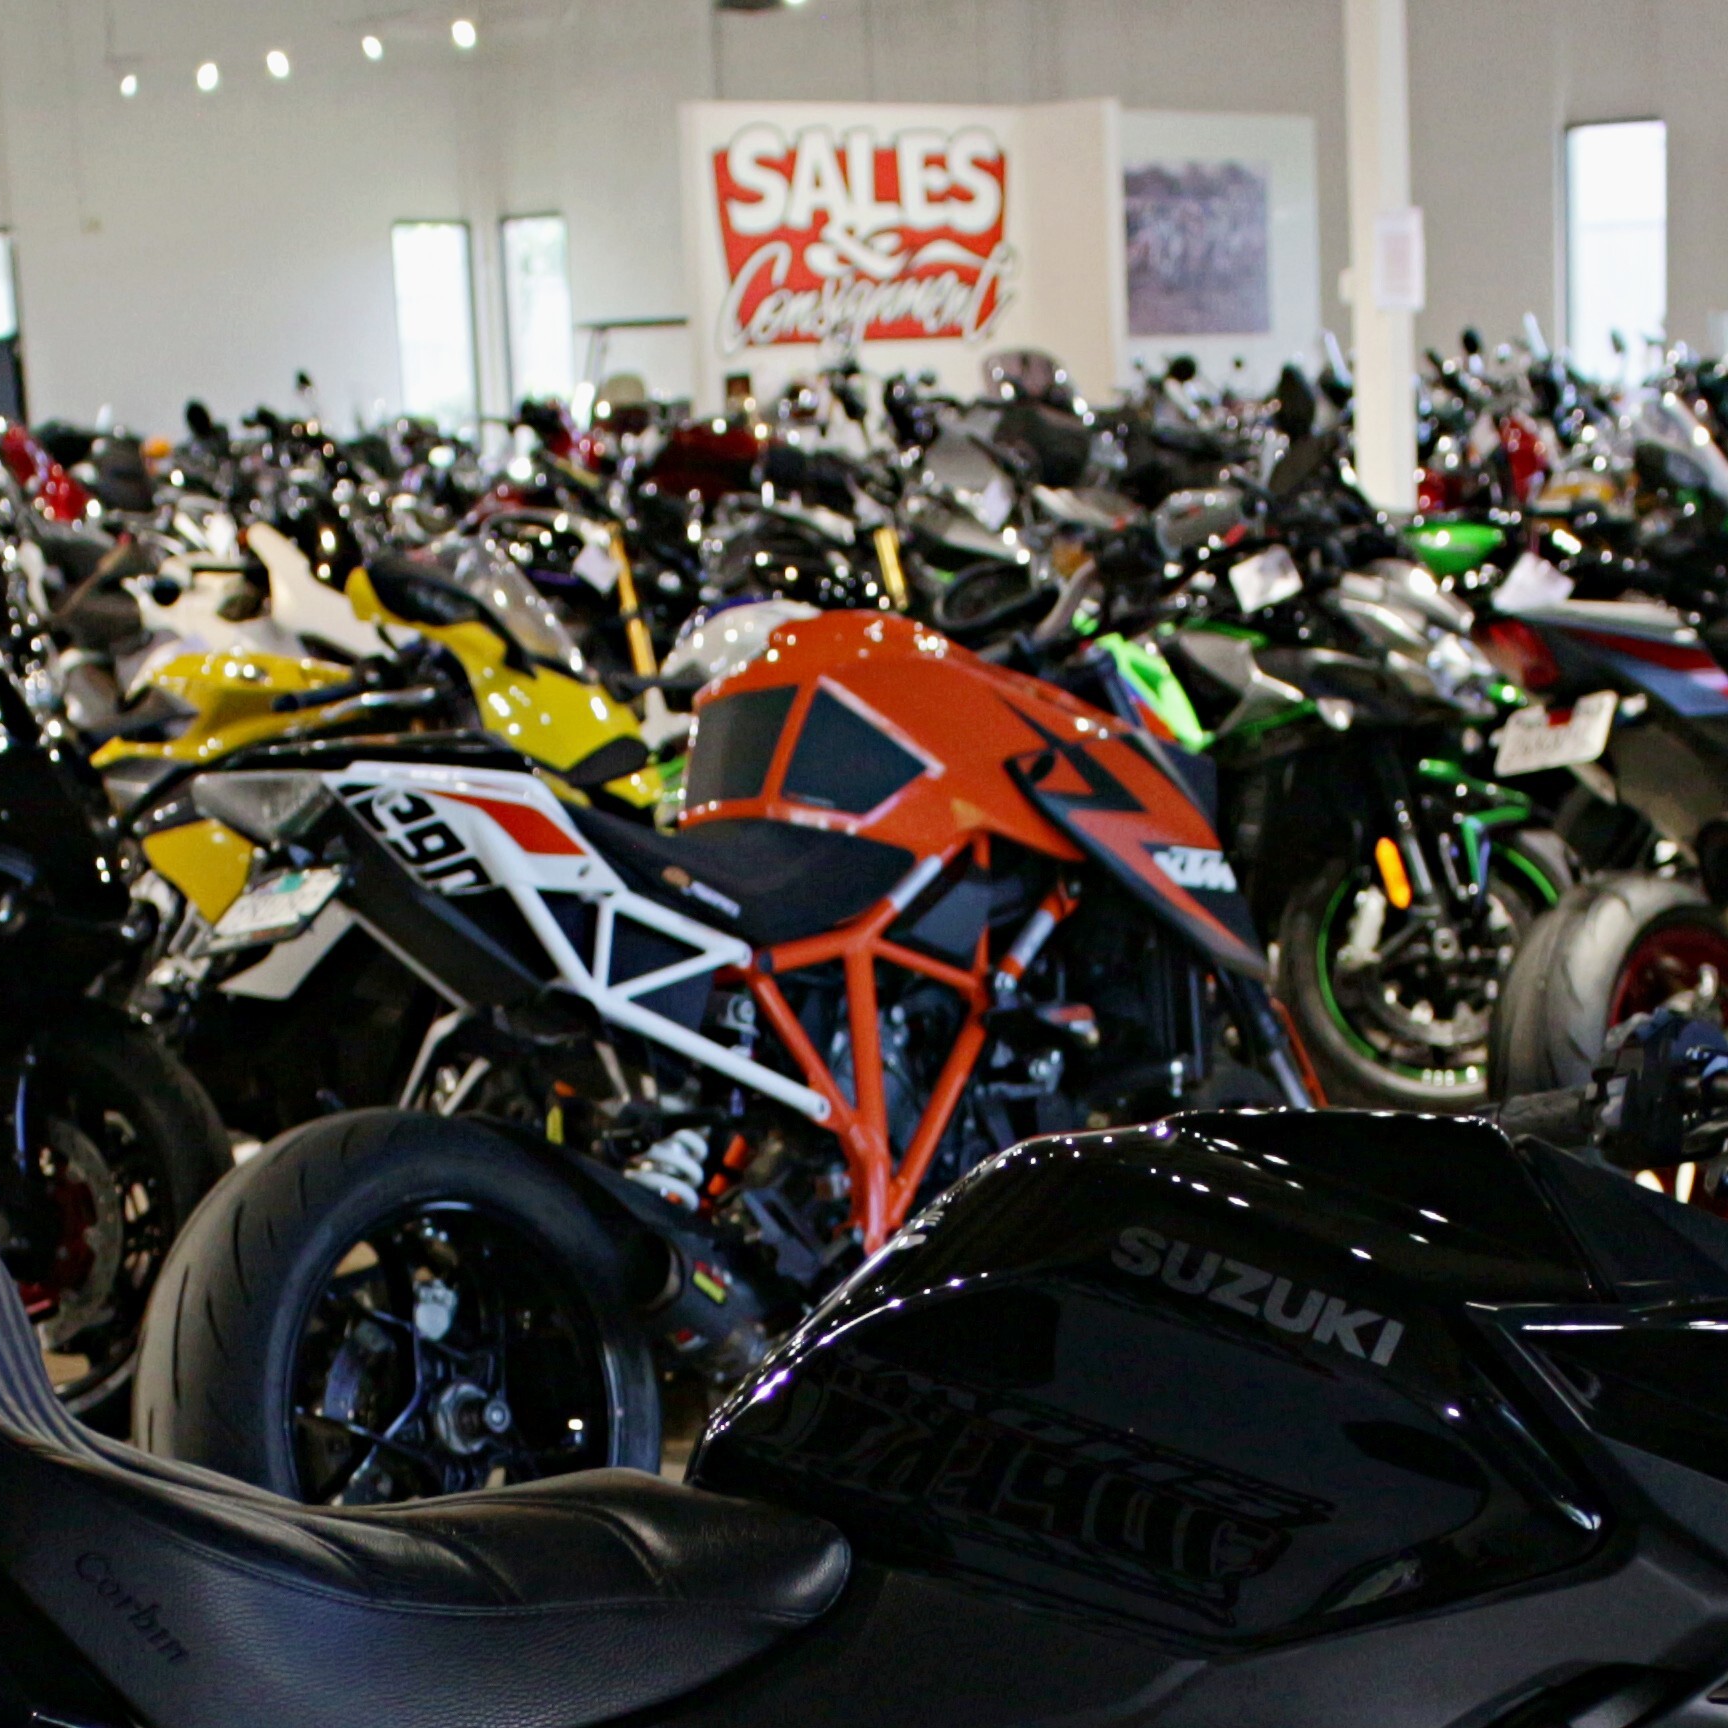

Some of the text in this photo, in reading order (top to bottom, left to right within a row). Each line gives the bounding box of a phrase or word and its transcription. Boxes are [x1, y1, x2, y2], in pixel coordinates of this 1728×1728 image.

[727, 121, 1003, 236] SALES
[717, 241, 1014, 354] Consignment
[803, 222, 906, 279] &
[1153, 845, 1237, 893] KTM
[1109, 1225, 1405, 1367] SUZUKI
[75, 1551, 189, 1664] Corbin
